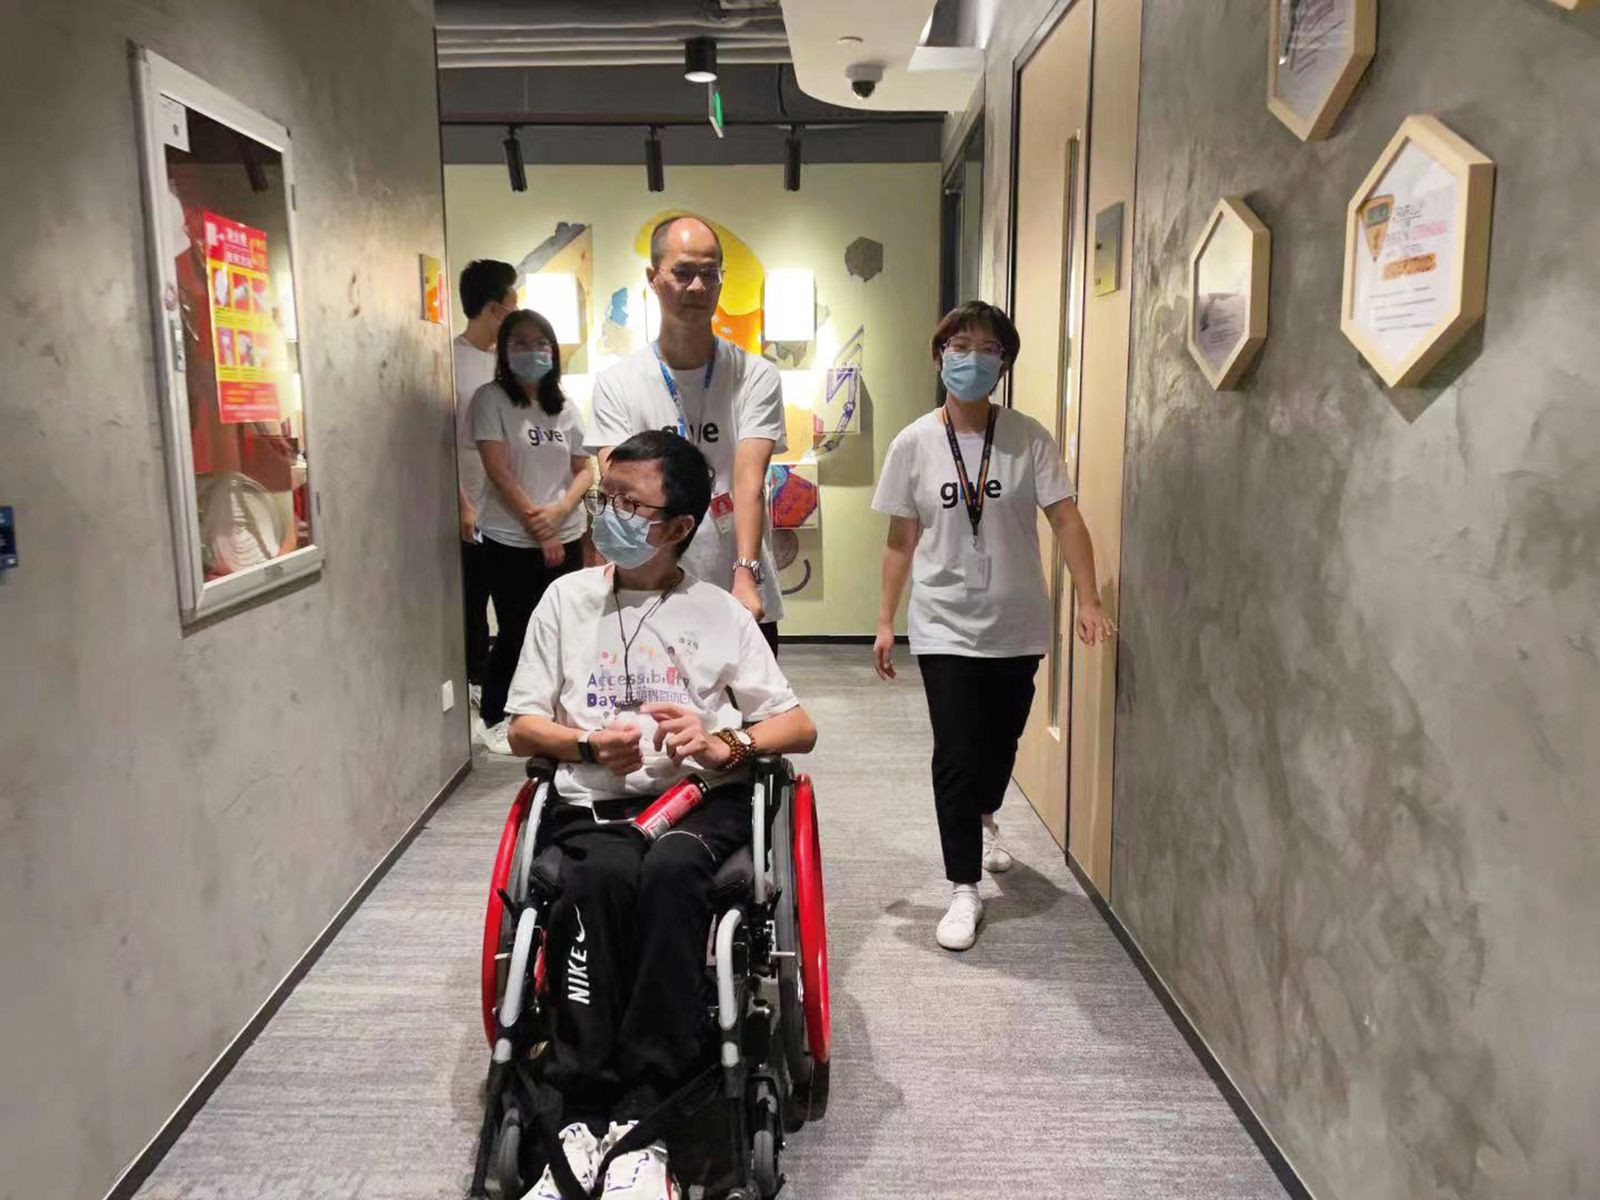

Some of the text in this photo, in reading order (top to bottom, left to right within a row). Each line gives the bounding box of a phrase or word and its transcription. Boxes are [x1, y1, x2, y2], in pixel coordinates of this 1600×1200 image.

[528, 426, 563, 447] give
[587, 692, 617, 710] Day
[568, 946, 590, 1005] NIKE
